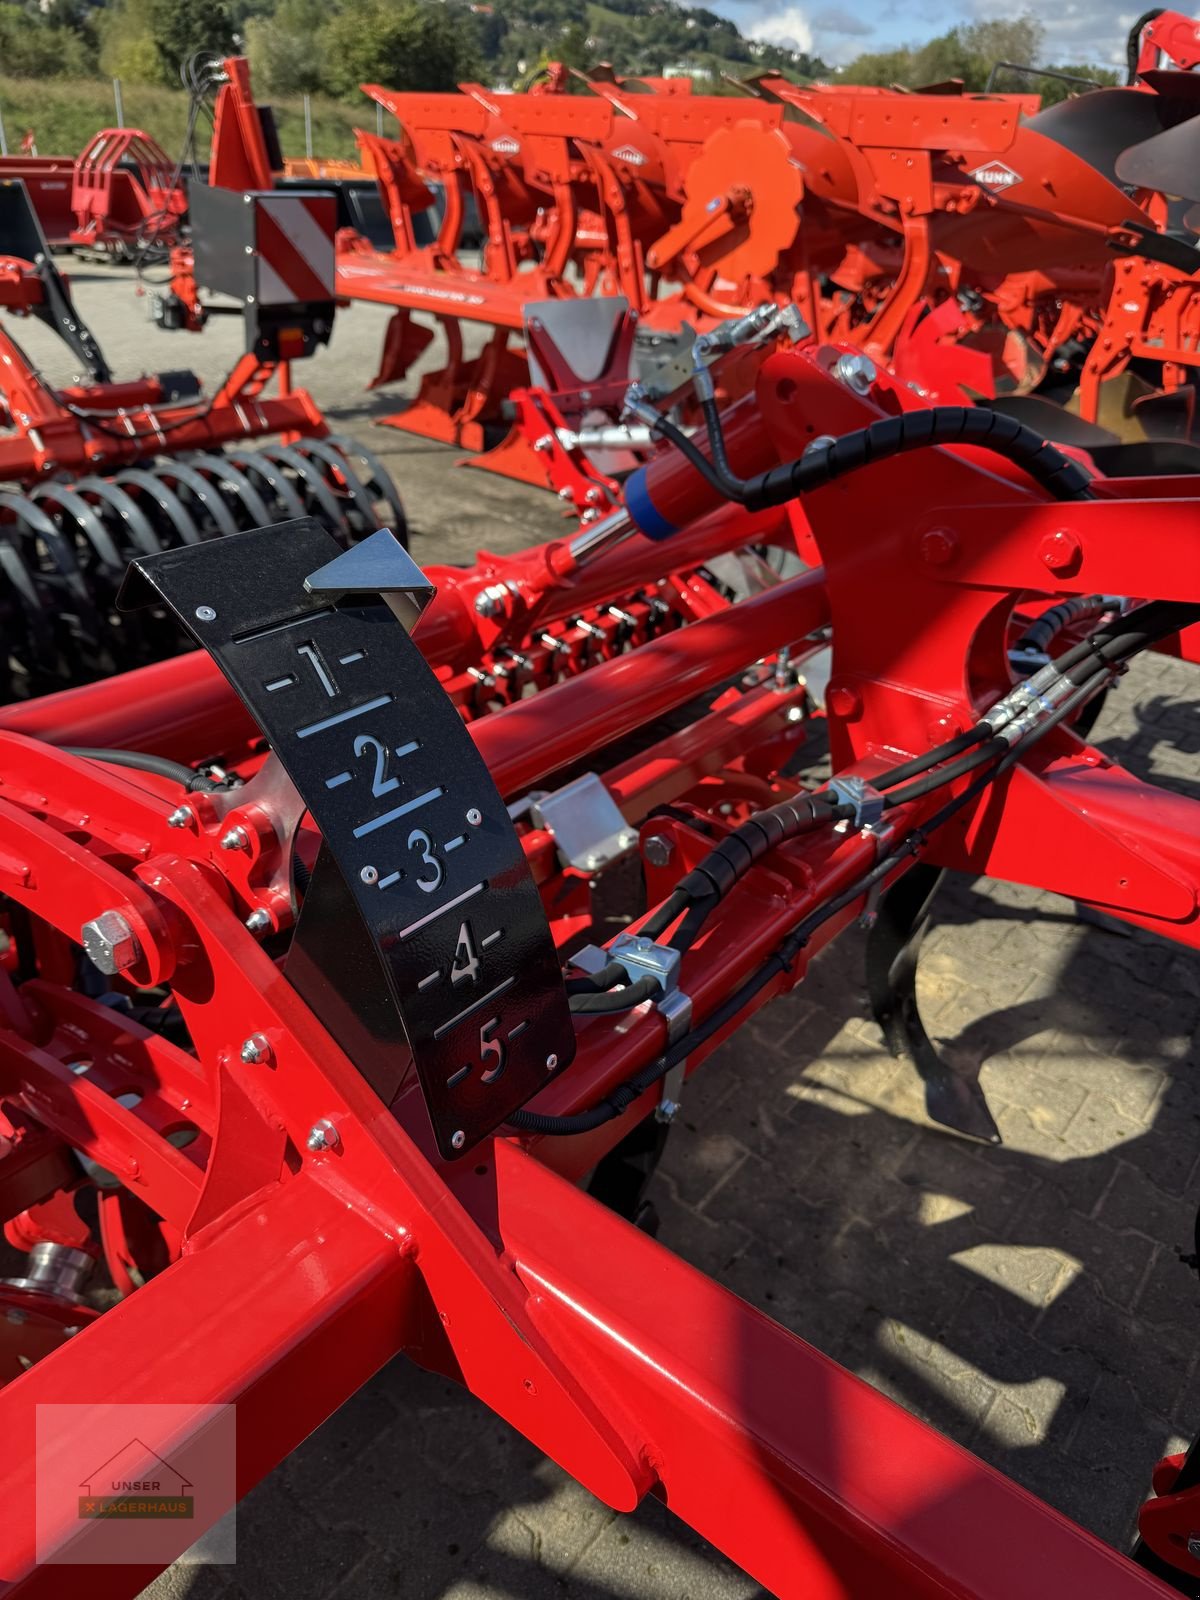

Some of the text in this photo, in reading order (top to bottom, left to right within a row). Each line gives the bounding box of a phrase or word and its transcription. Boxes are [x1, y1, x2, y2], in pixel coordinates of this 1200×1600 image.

[298, 640, 338, 697] 1
[353, 734, 402, 798] 2
[406, 828, 447, 894] 3
[451, 920, 480, 987] 4
[480, 1016, 508, 1086] 5
